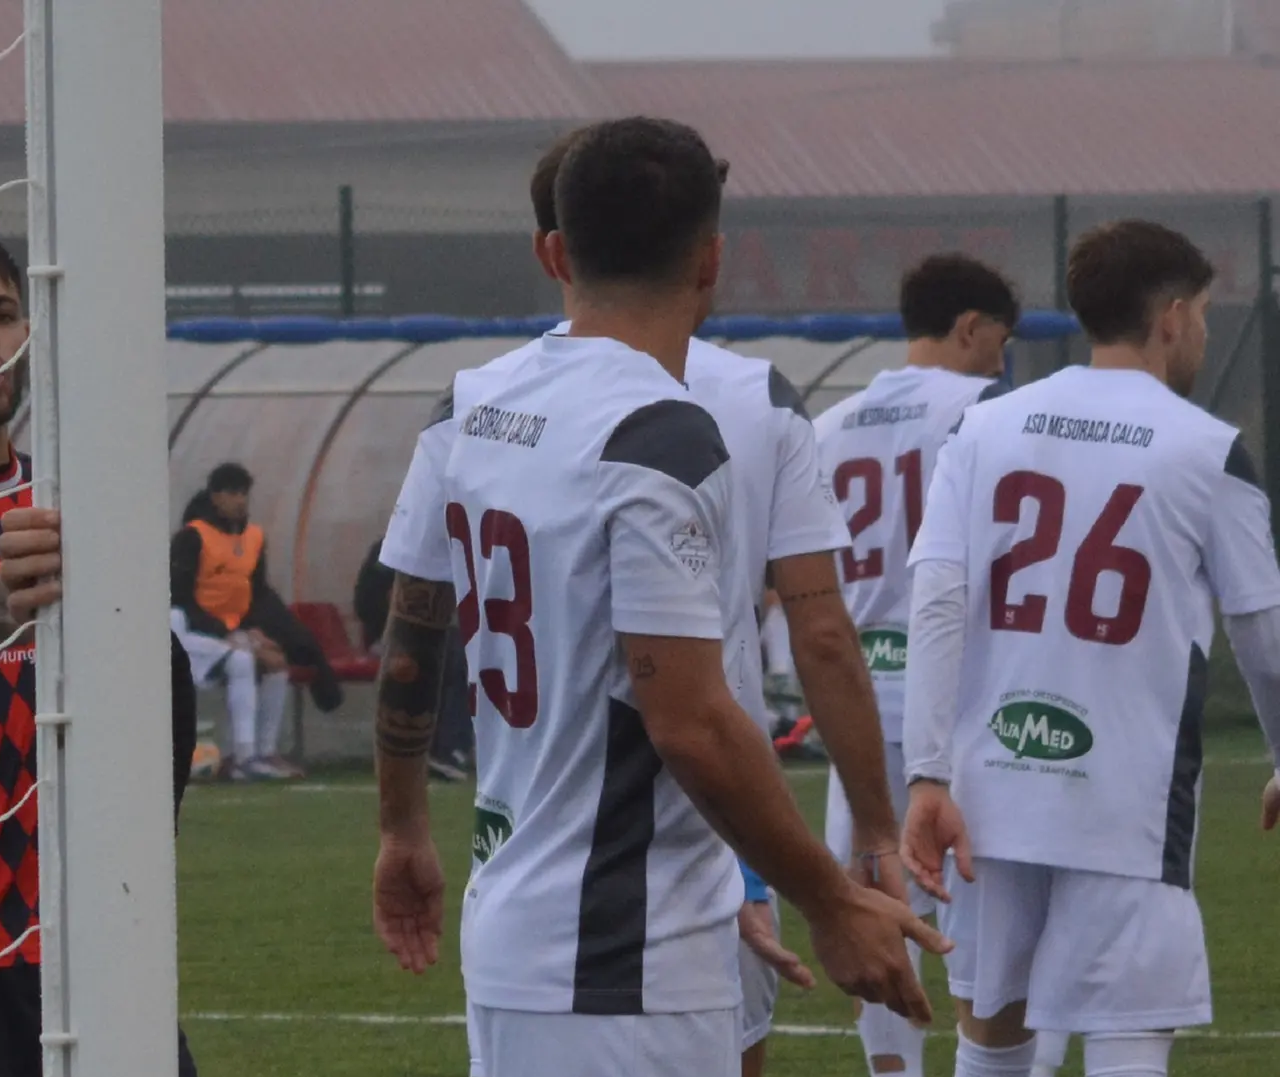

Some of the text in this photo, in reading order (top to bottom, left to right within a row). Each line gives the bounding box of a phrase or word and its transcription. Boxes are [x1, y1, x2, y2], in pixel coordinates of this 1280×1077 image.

[1022, 413, 1154, 448] ASD MESORACA CALCIO
[833, 448, 923, 584] 21
[991, 470, 1152, 645] 26
[446, 502, 538, 729] 23
